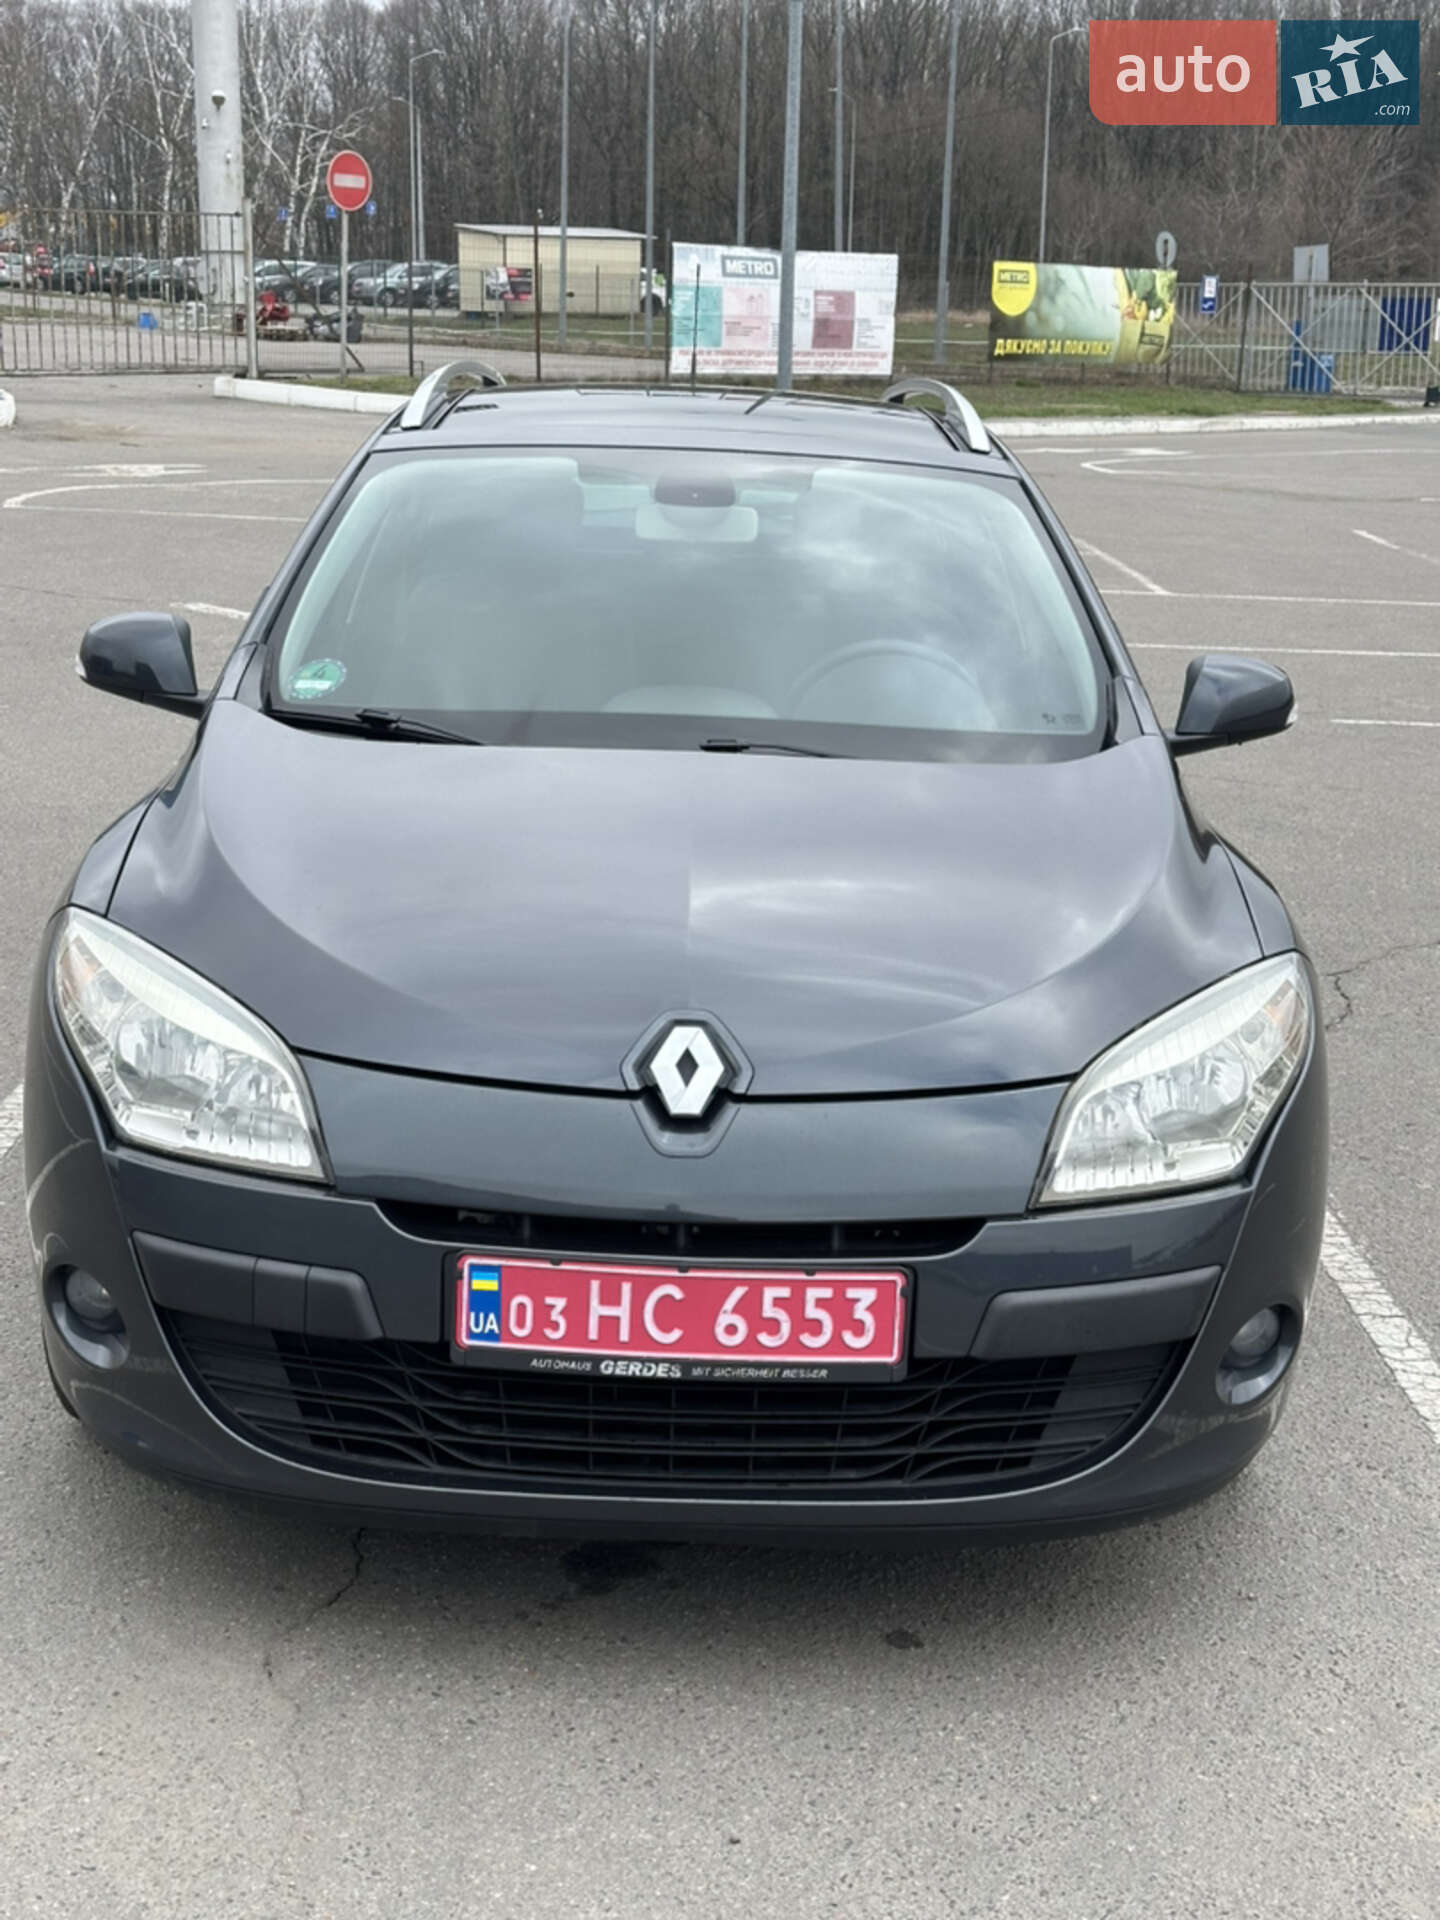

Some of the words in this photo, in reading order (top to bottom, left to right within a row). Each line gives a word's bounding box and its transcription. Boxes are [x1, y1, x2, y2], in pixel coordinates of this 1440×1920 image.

[726, 259, 775, 276] METRO
[999, 271, 1029, 283] METRO
[1048, 338, 1062, 355] ЗА
[469, 1310, 500, 1335] UA
[507, 1294, 567, 1340] 03
[587, 1279, 686, 1345] HC
[714, 1286, 878, 1350] 6553
[530, 1358, 593, 1372] AUTOHAUS
[599, 1359, 683, 1378] GERDES
[691, 1366, 711, 1376] MIT
[712, 1367, 781, 1378] SICHERHEIT
[781, 1368, 829, 1379] BESSER
